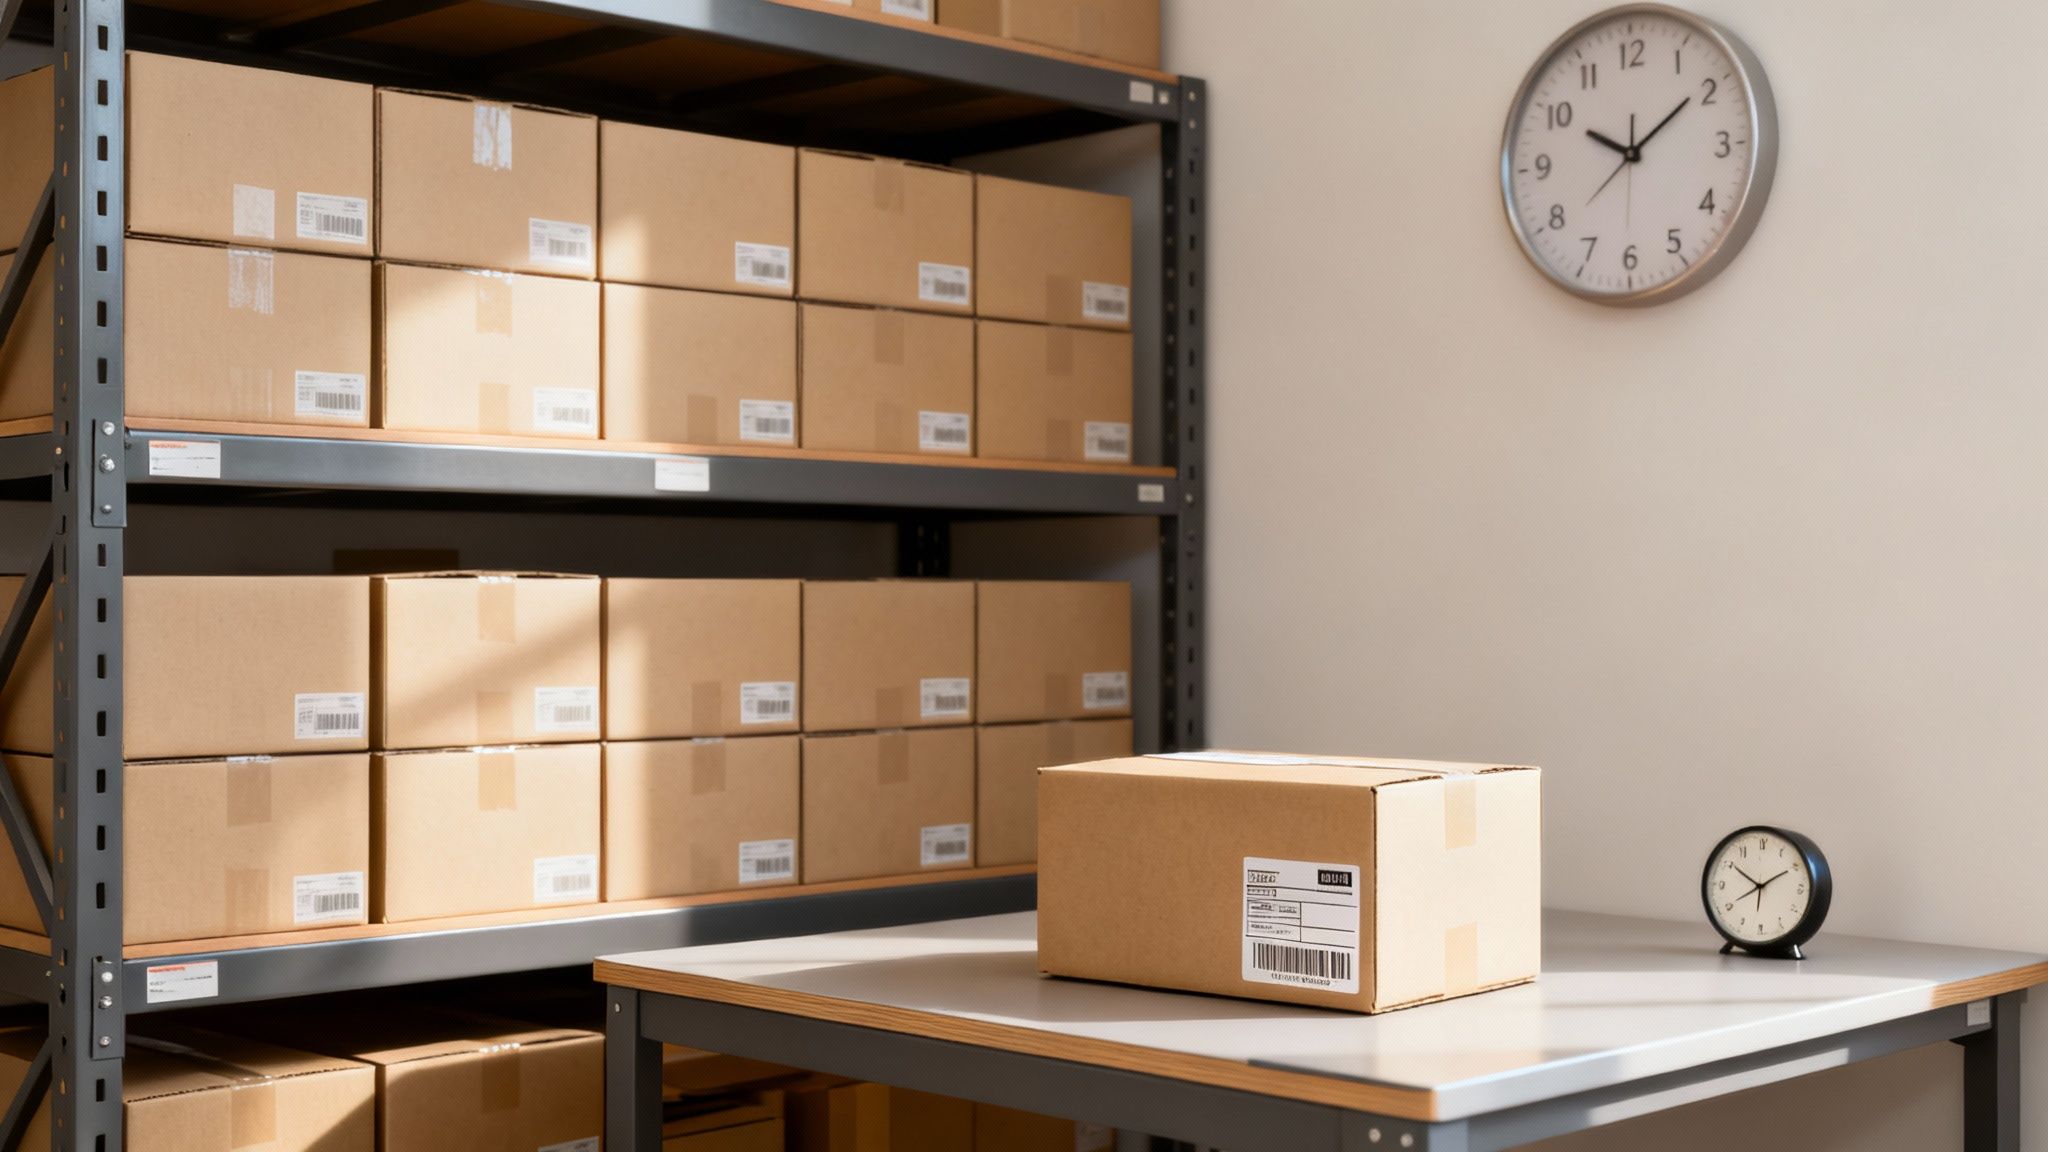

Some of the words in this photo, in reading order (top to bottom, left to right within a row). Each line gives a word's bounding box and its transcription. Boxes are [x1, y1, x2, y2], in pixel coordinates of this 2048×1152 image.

[1619, 39, 1645, 70] 12
[1675, 50, 1681, 75] 1
[1580, 63, 1597, 90] 11
[1701, 78, 1717, 105] 2
[1548, 101, 1573, 130] 10
[1715, 131, 1731, 158] 3
[1535, 154, 1551, 180] 9
[1699, 188, 1716, 215] 4
[1549, 204, 1565, 230] 8
[1580, 237, 1597, 262] 7
[1667, 229, 1682, 254] 5
[1623, 245, 1638, 270] 6
